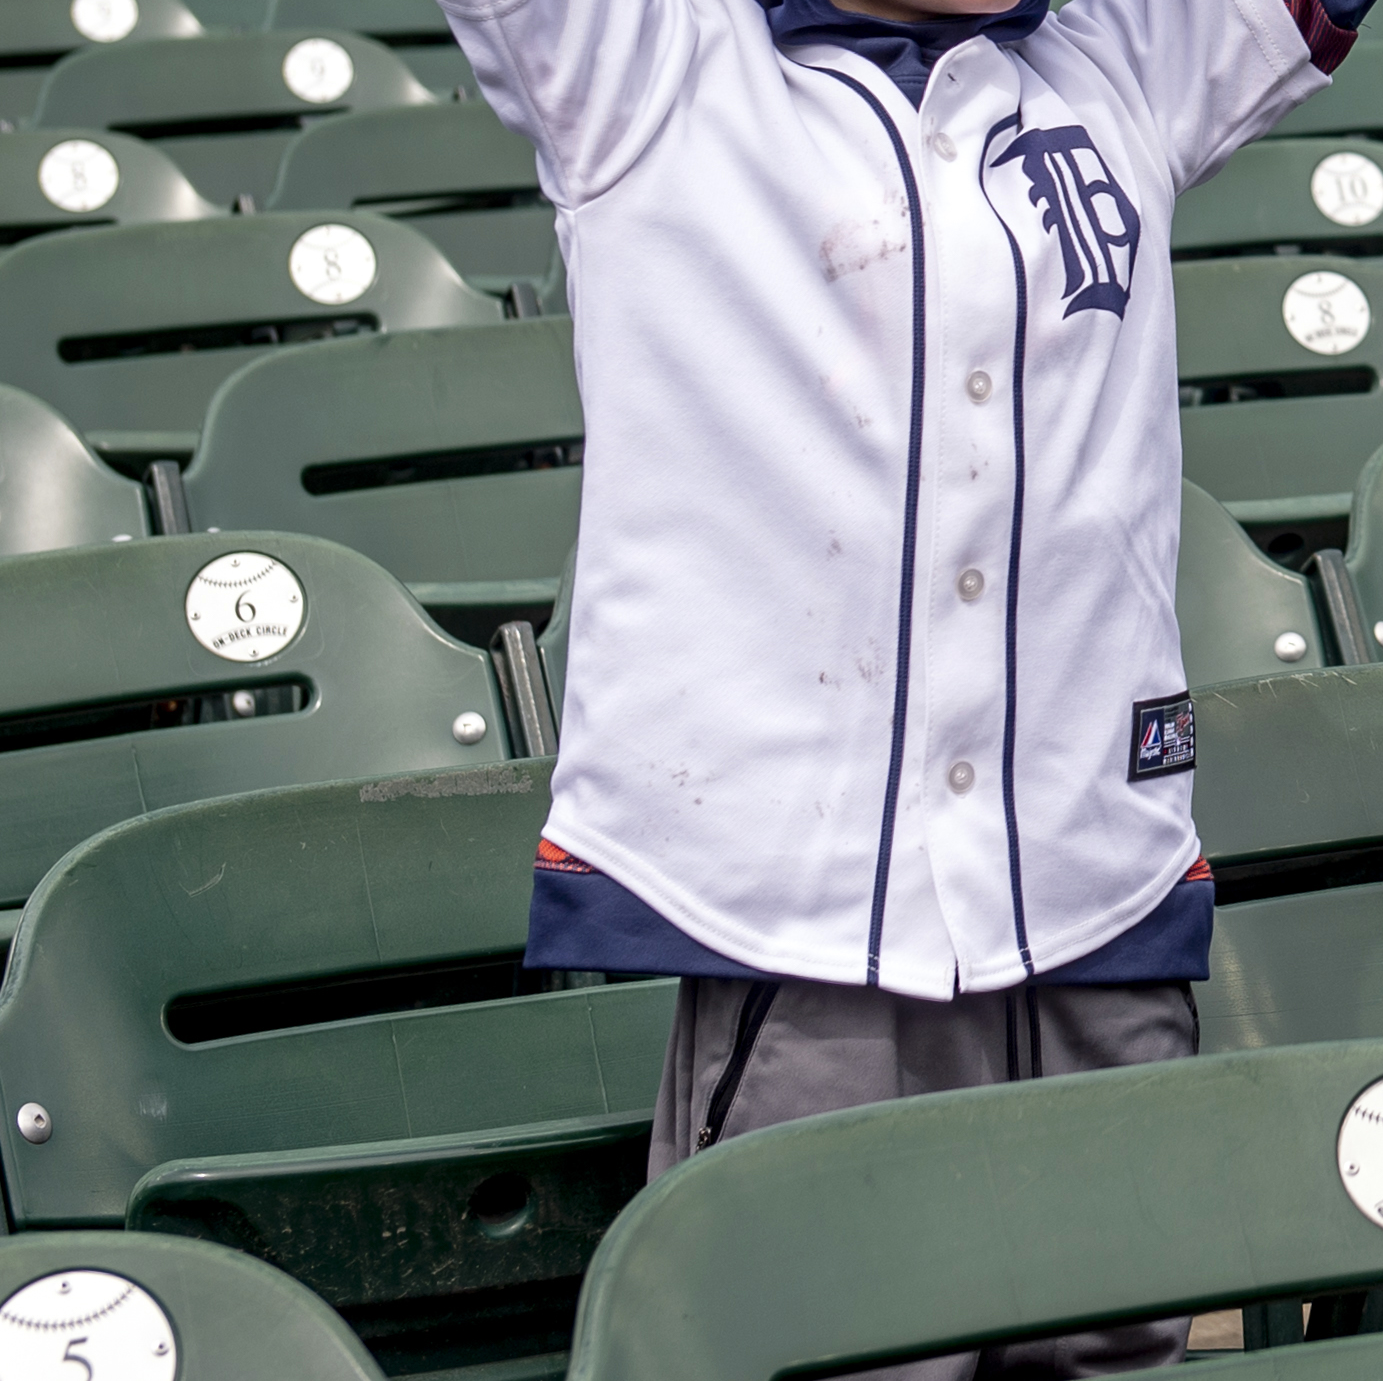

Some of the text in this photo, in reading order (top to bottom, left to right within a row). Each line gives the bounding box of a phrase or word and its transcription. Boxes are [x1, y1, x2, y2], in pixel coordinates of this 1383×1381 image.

[1334, 174, 1370, 205] 10
[989, 125, 1141, 322] D
[321, 247, 342, 282] 8
[1318, 298, 1336, 325] 8
[234, 589, 257, 623] 6
[212, 624, 288, 650] ON-DECK CIRCLE
[62, 1336, 94, 1381] 5
